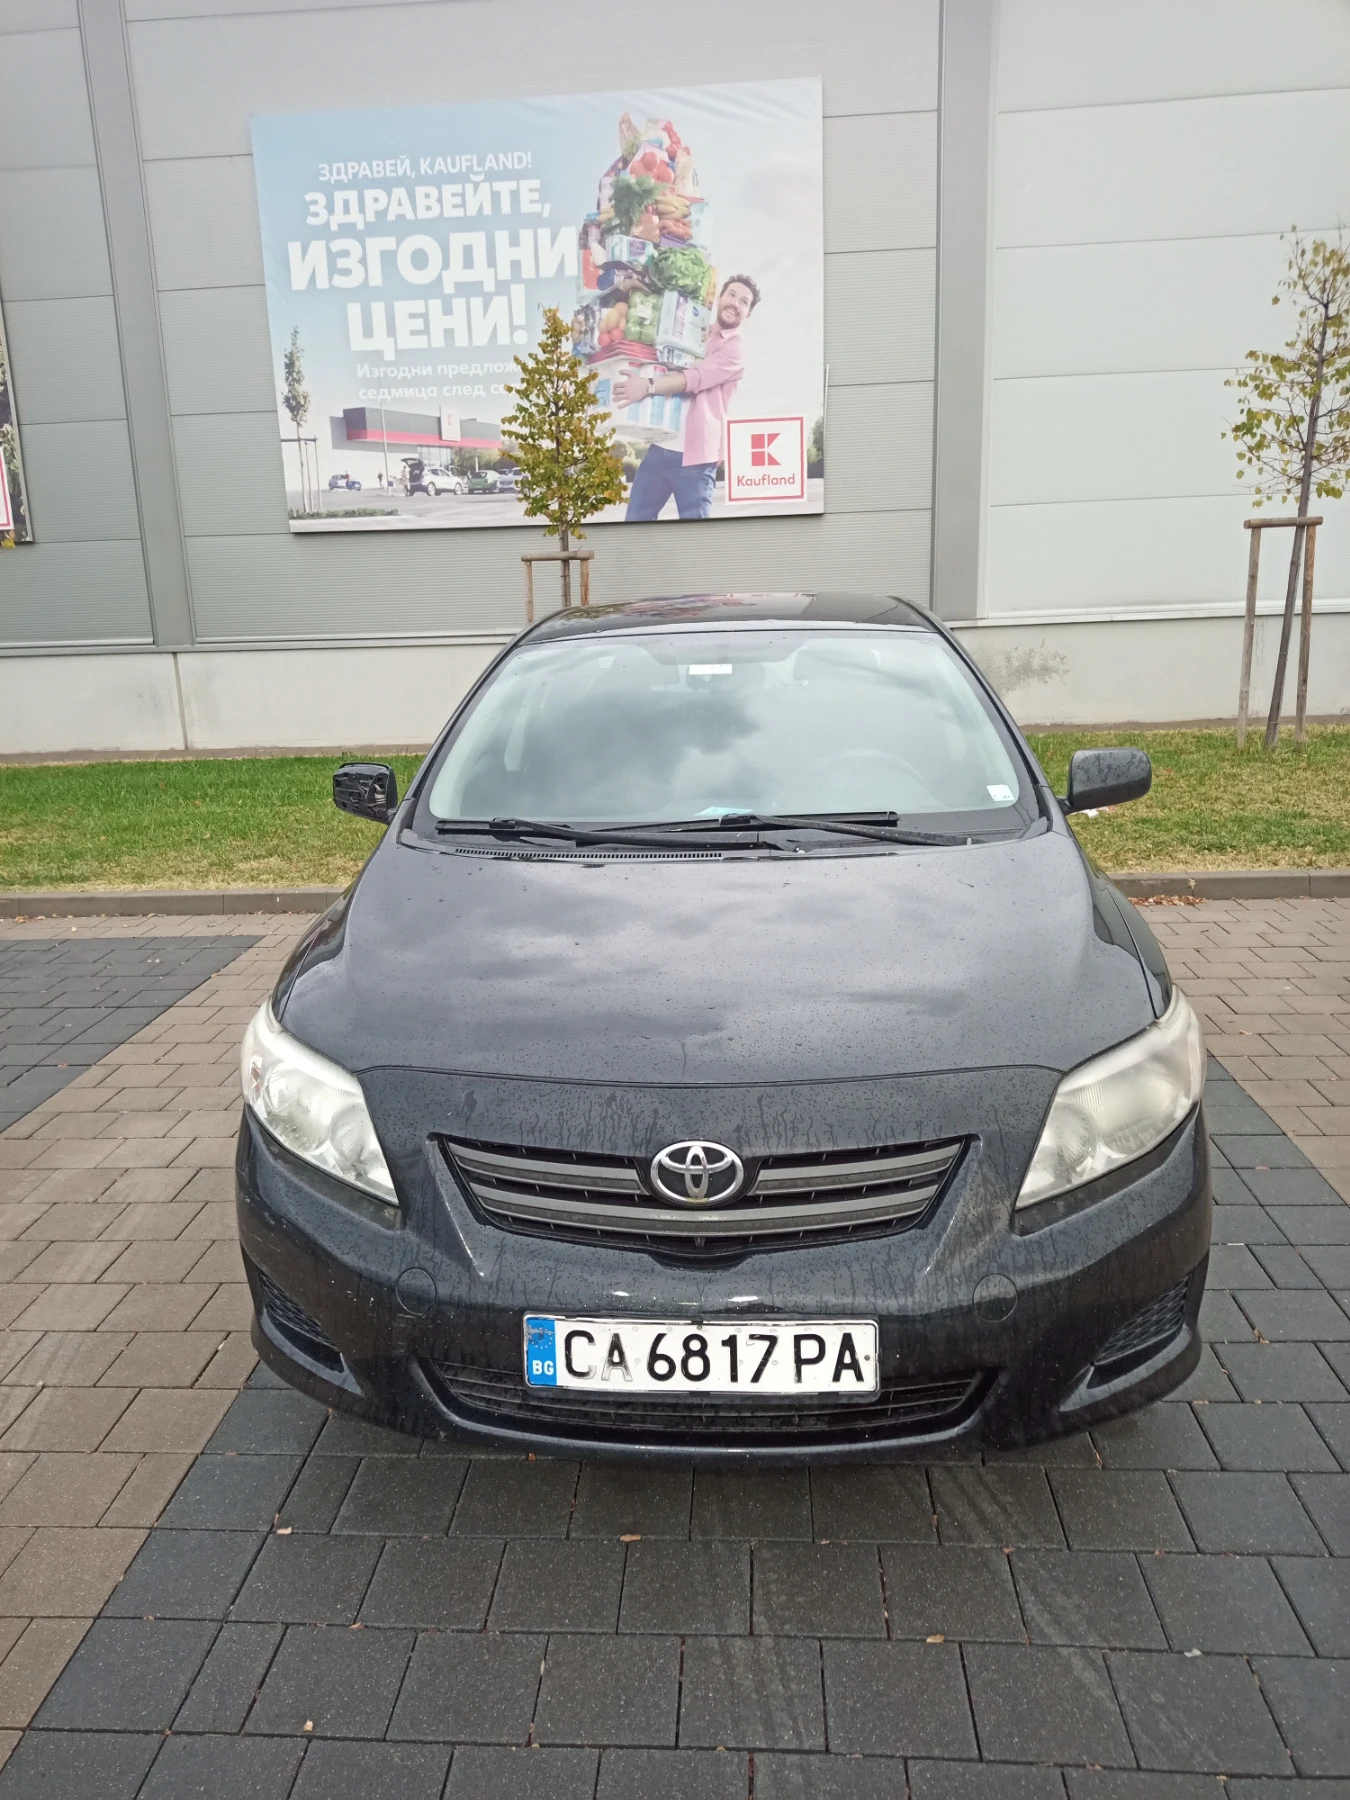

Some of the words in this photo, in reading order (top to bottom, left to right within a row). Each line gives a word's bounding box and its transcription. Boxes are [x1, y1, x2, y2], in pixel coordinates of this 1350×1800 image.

[318, 154, 416, 184] ЗДРАВЕЙ,
[419, 151, 533, 176] KAUFLAND!
[304, 172, 551, 232] ЗДРАВЕЙТЕ,
[287, 226, 579, 294] ИЗГОДНИ
[347, 284, 529, 361] ЦЕНИ!
[356, 363, 433, 380] Изгодни
[437, 361, 521, 379] предлож
[359, 386, 438, 401] седмица
[442, 384, 486, 398] след
[737, 473, 795, 487] Kaufland
[532, 1359, 555, 1376] BG
